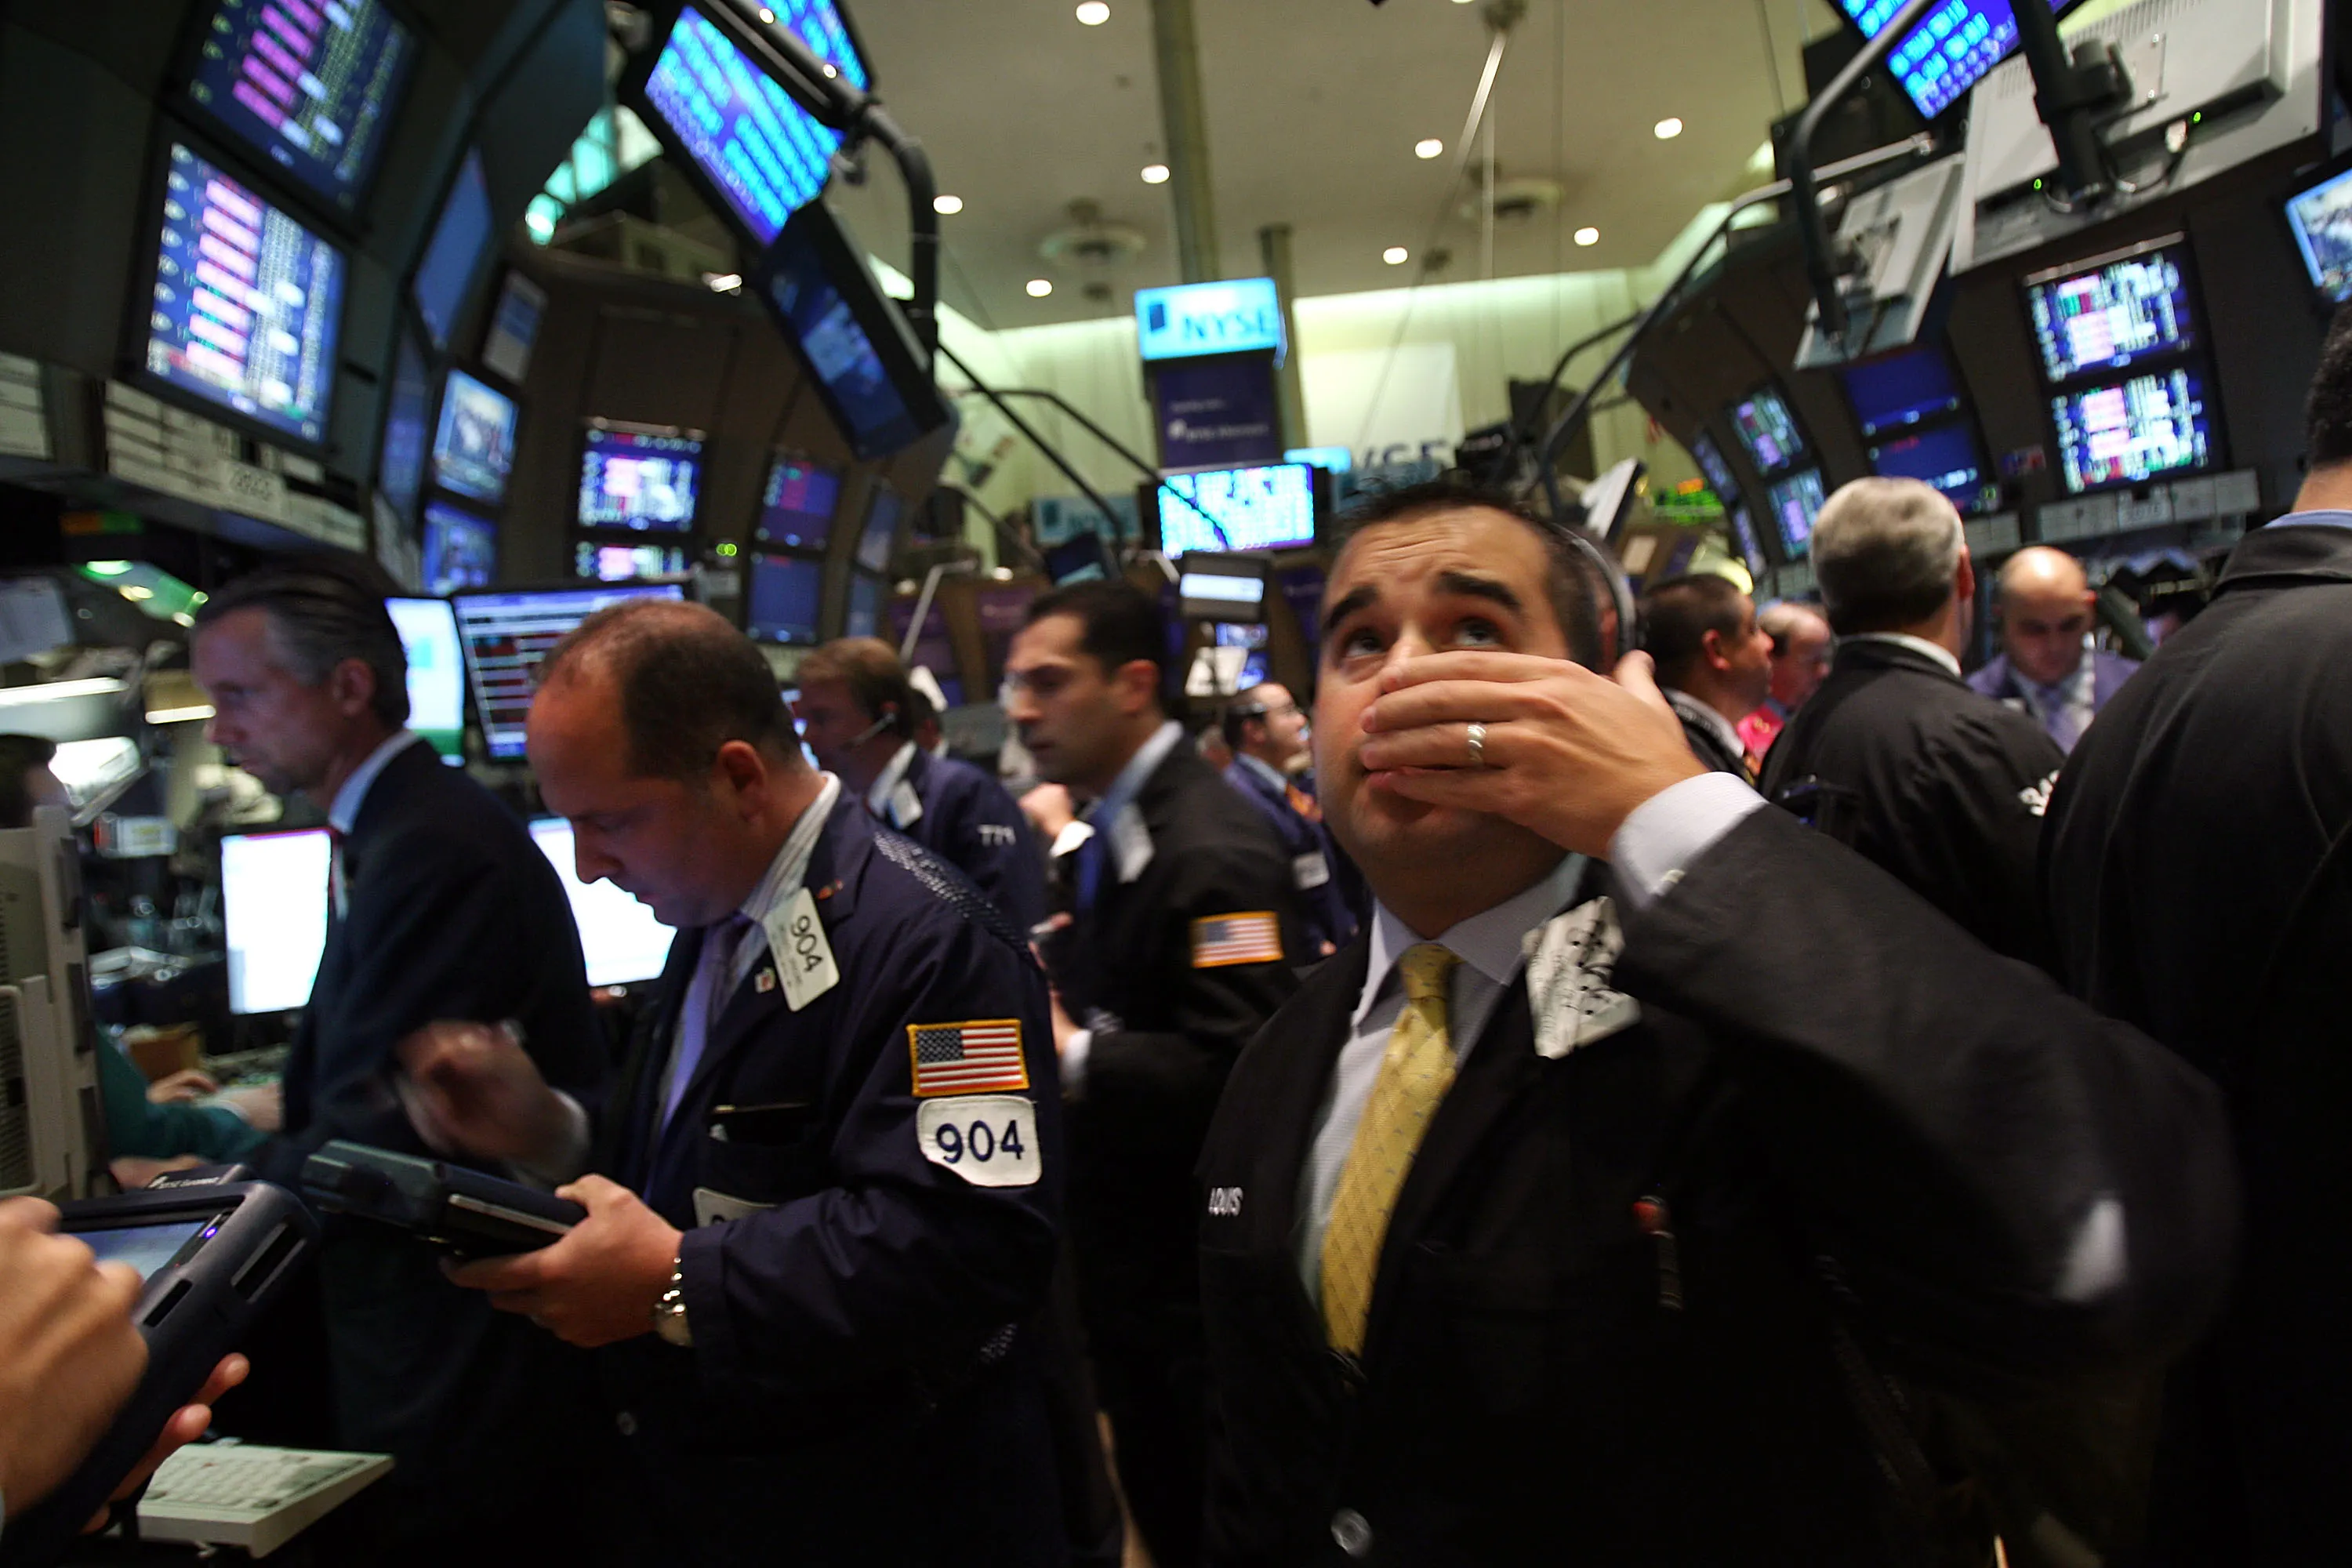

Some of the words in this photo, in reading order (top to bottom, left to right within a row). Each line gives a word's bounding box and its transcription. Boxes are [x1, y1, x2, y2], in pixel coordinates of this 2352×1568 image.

[1181, 305, 1276, 342] NYSE
[791, 916, 822, 972] 904
[936, 1120, 1024, 1163] 904
